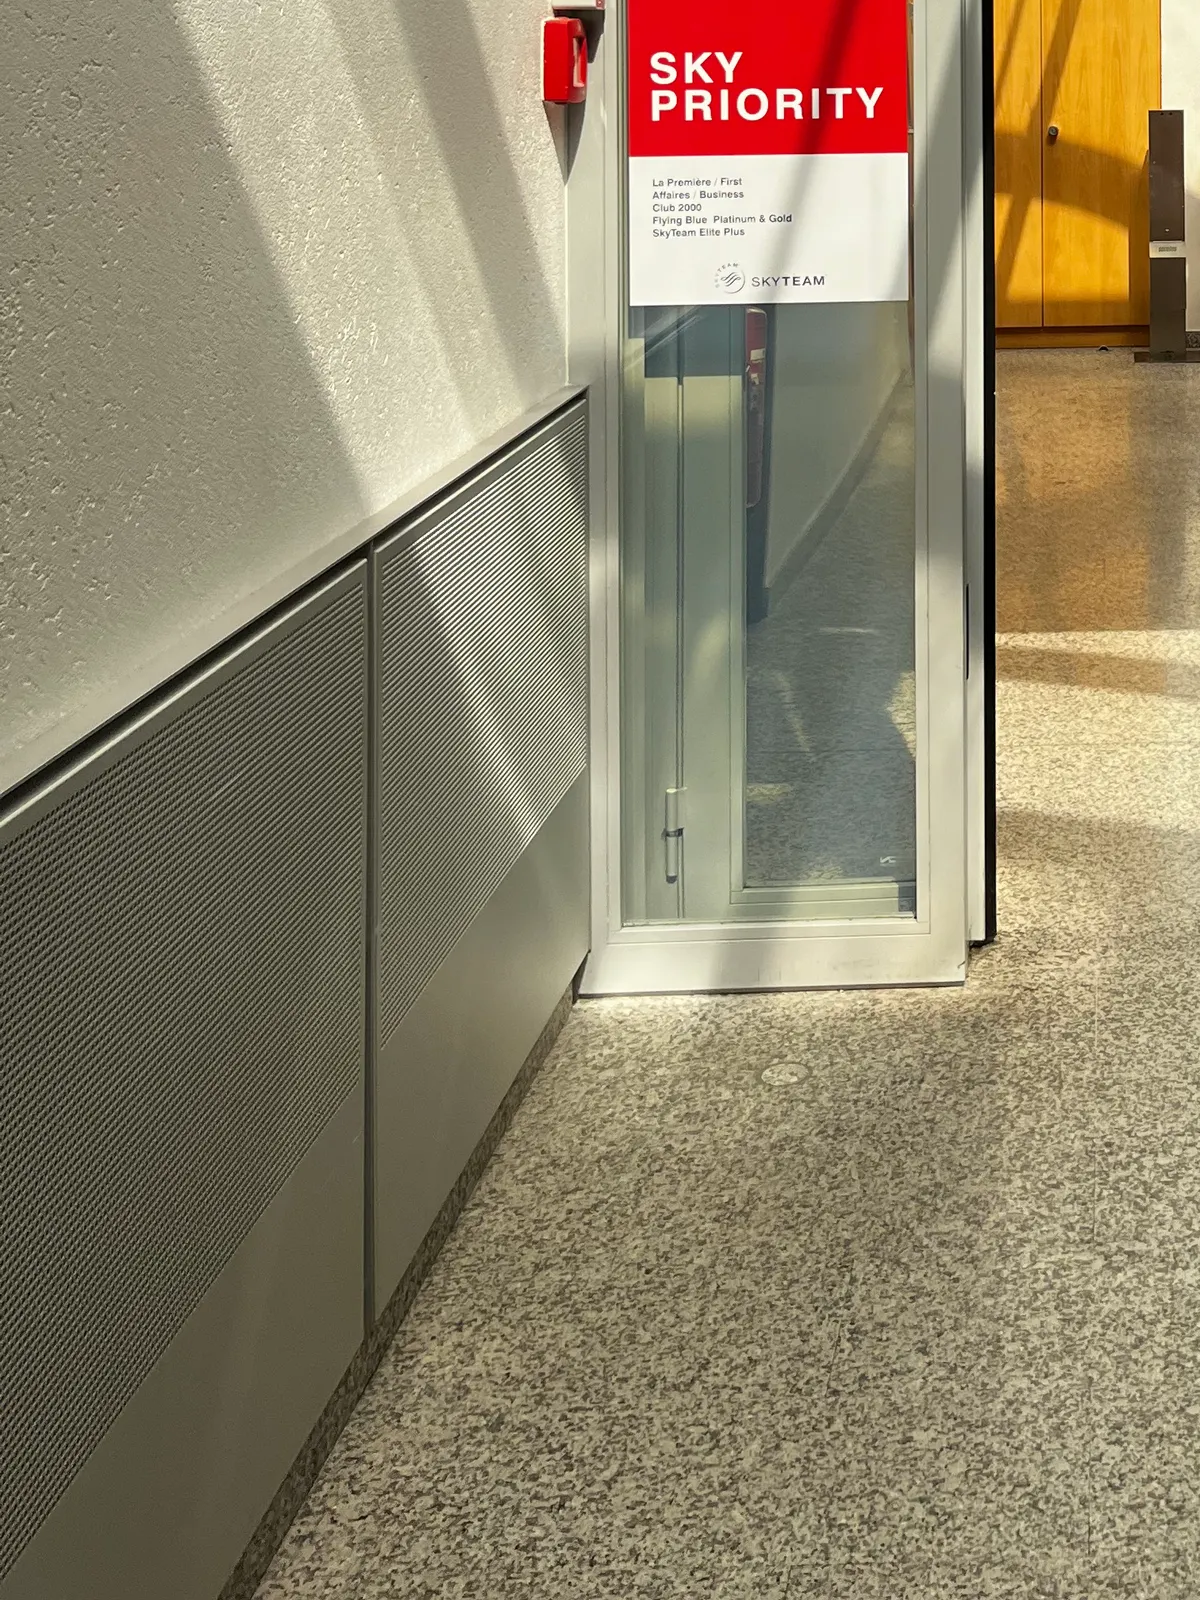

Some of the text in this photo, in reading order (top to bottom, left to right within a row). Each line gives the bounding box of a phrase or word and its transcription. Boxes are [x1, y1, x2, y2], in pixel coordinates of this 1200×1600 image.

[650, 51, 743, 85] SKY
[651, 86, 884, 122] PRIORITY
[652, 178, 664, 187] La
[667, 177, 712, 187] Première
[720, 177, 743, 186] First
[652, 191, 691, 200] Affaires
[699, 190, 745, 199] Business
[652, 203, 702, 212] Club 2000
[652, 214, 793, 227] Flying Blue Platinum & Gold
[652, 227, 746, 239] SkyTeam Elite Plus
[751, 276, 826, 288] SKYTEAM
